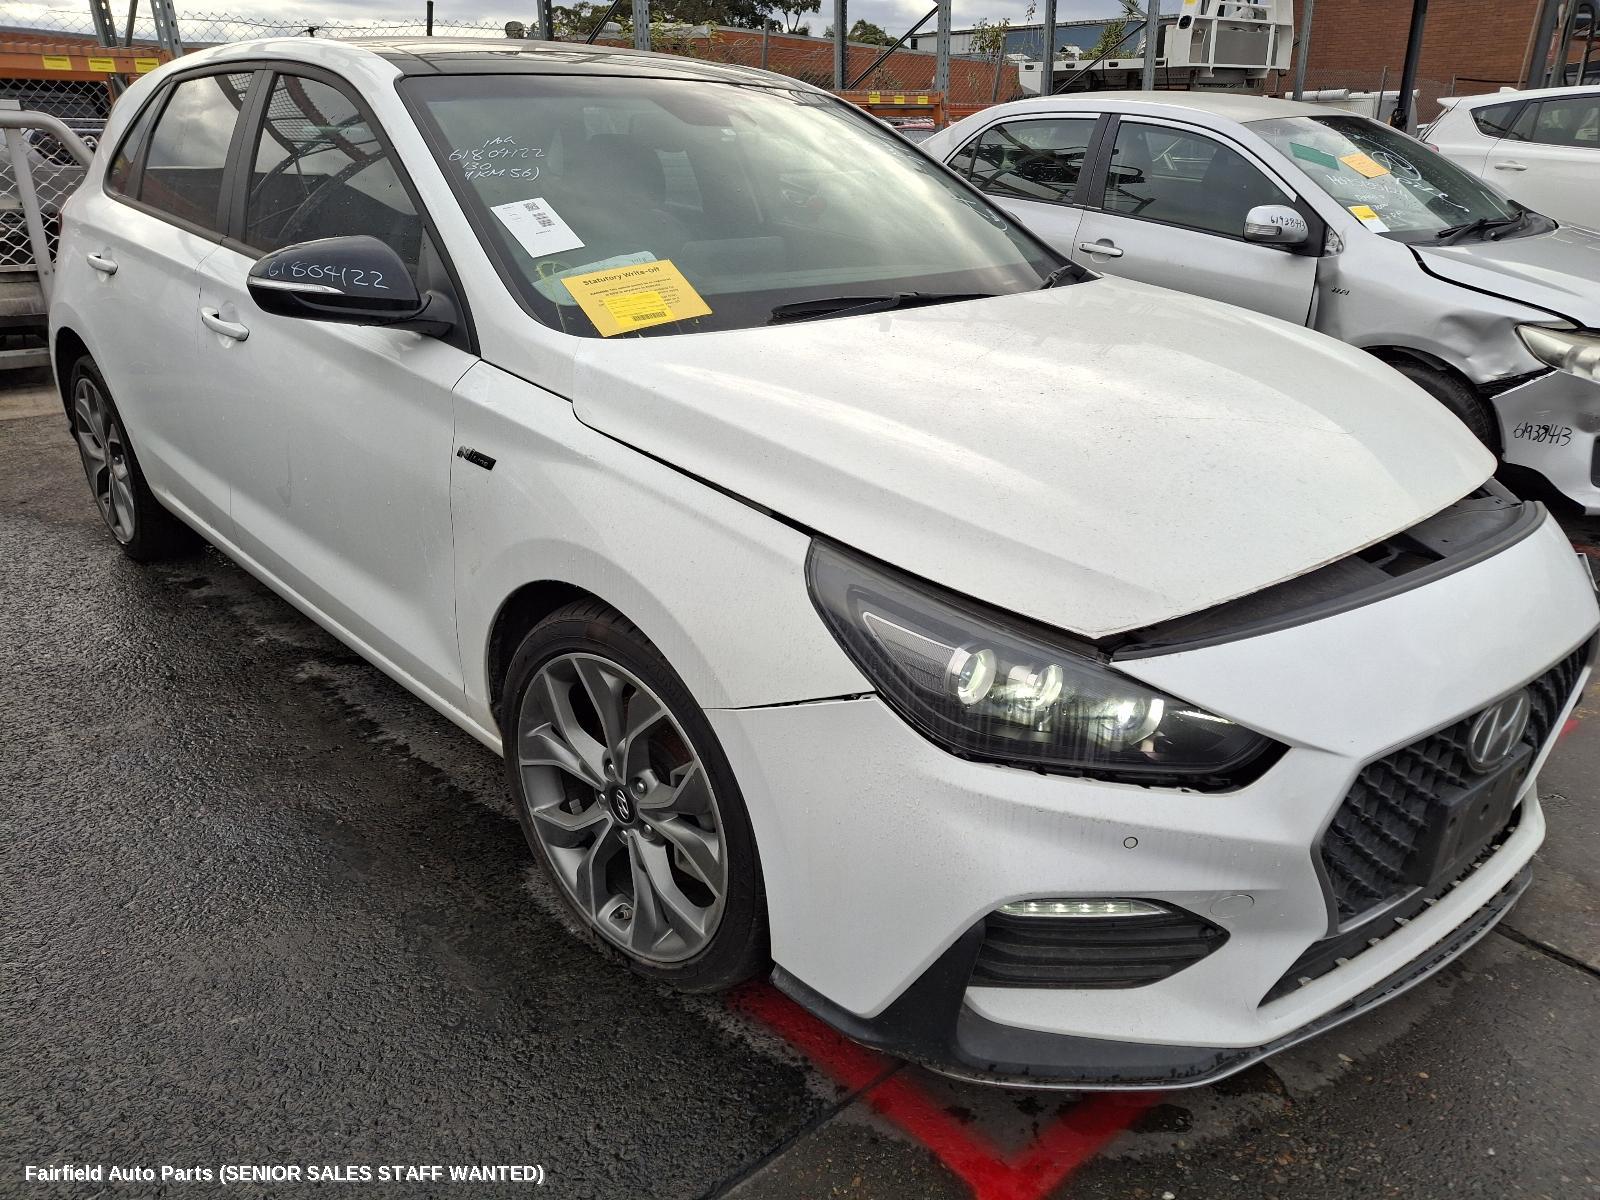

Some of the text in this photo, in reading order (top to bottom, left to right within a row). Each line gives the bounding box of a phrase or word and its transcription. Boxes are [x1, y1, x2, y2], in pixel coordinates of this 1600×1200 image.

[448, 147, 546, 161] 61804122
[1270, 215, 1306, 232] 61938413
[268, 261, 390, 290] 61804122
[582, 266, 661, 286] Statutory Write-Off
[1513, 422, 1573, 447] 61938413
